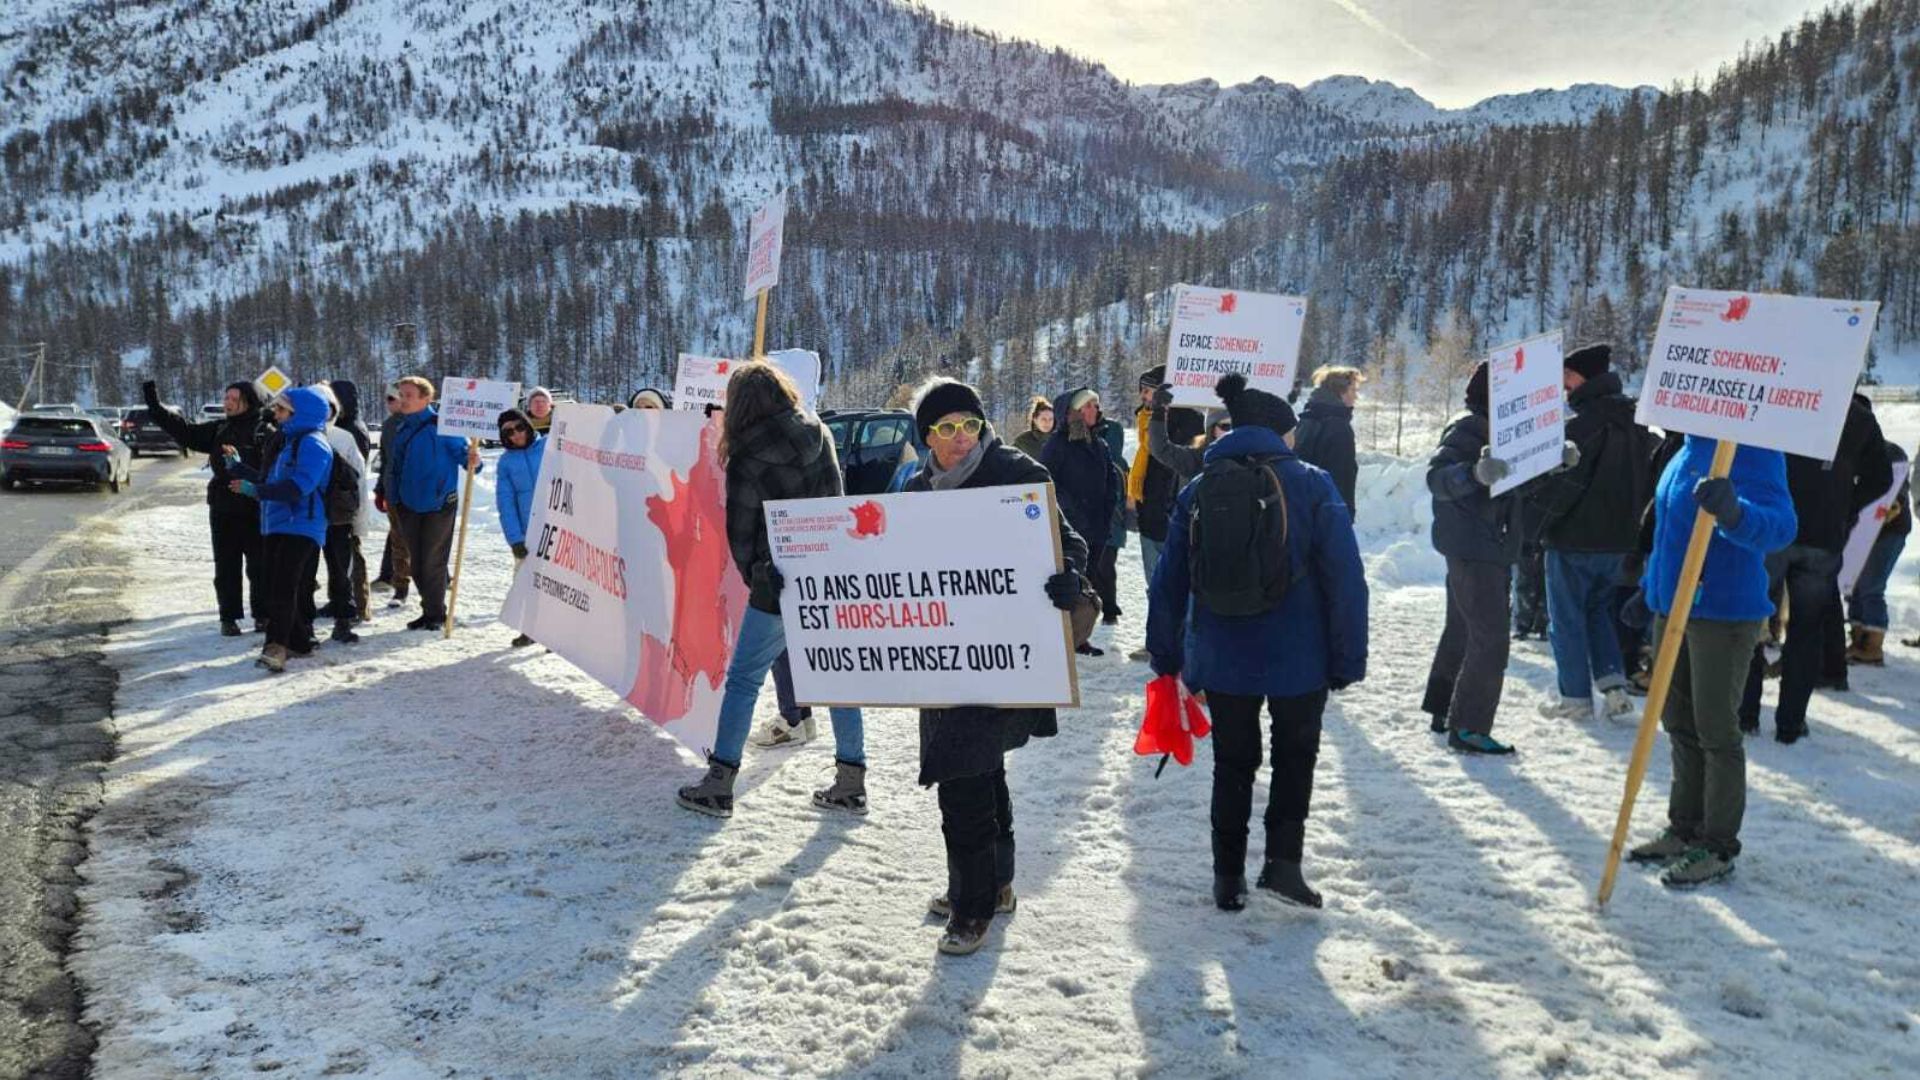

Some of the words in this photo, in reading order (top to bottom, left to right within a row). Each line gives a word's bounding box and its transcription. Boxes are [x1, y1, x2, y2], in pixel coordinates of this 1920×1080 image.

[1180, 333, 1212, 350] ESPACE
[1214, 336, 1259, 352] SCHENGEN
[1190, 358, 1206, 372] EST
[1241, 362, 1252, 376] LA
[1666, 344, 1710, 366] ESPACE
[1712, 350, 1780, 374] SCHENGEN
[1174, 372, 1185, 386] DE
[1187, 373, 1216, 388] CIRCUL
[1677, 374, 1698, 392] EST
[1700, 376, 1746, 400] PASSÉE
[1748, 384, 1765, 403] LA
[1767, 386, 1824, 412] LIBERTÉ
[1654, 389, 1670, 406] DE
[1671, 392, 1748, 420] CIRCULATION
[1750, 405, 1759, 422] ?
[549, 478, 562, 510] 10
[536, 523, 558, 560] DE
[795, 576, 818, 600] 10
[824, 574, 862, 600] ANS
[866, 572, 904, 600] QUE
[908, 571, 933, 598] LA
[938, 568, 1018, 596] FRANCE
[799, 605, 830, 630] EST
[835, 601, 954, 629] HORS-LA-LOI.
[804, 646, 854, 672] VOUS
[858, 646, 882, 672] EN
[888, 645, 962, 672] PENSEZ
[967, 644, 1015, 672] QUOI
[1020, 644, 1031, 670] ?
